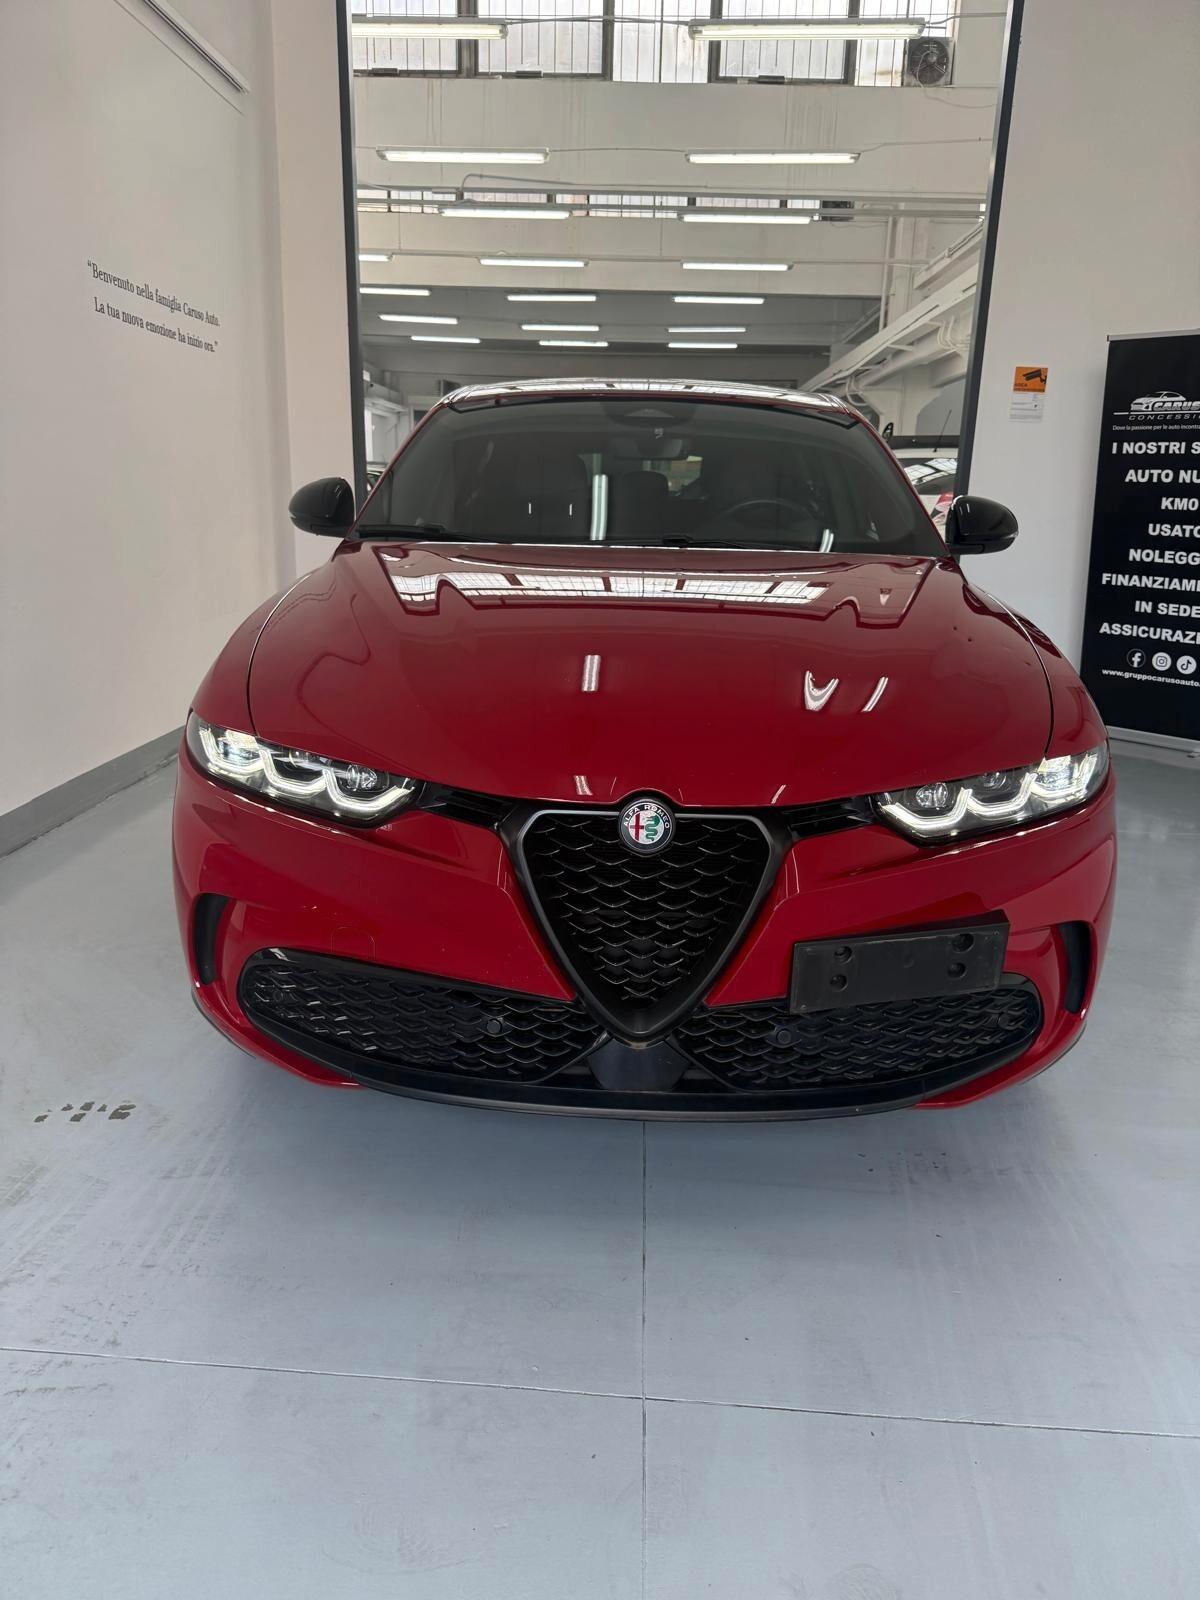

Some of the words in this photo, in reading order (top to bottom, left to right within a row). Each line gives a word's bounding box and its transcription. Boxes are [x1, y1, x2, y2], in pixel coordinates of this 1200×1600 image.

[136, 283, 154, 301] nella
[155, 288, 182, 313] famiglia
[183, 302, 204, 321] Caruso
[93, 296, 105, 314] La
[107, 303, 121, 319] tua
[121, 311, 144, 329] nuova
[145, 321, 177, 340] emozione
[177, 328, 186, 343] ha
[187, 332, 203, 349] inizio
[1128, 413, 1200, 421] CONCESSI
[1112, 442, 1118, 454] I
[1122, 441, 1186, 454] NOSTRI
[1124, 469, 1174, 483] AUTO
[1128, 548, 1200, 566] NOLEGG
[1134, 600, 1153, 613] IN
[1157, 602, 1200, 618] SEDE
[623, 806, 641, 827] ALFA
[644, 804, 670, 829] ROMEO
